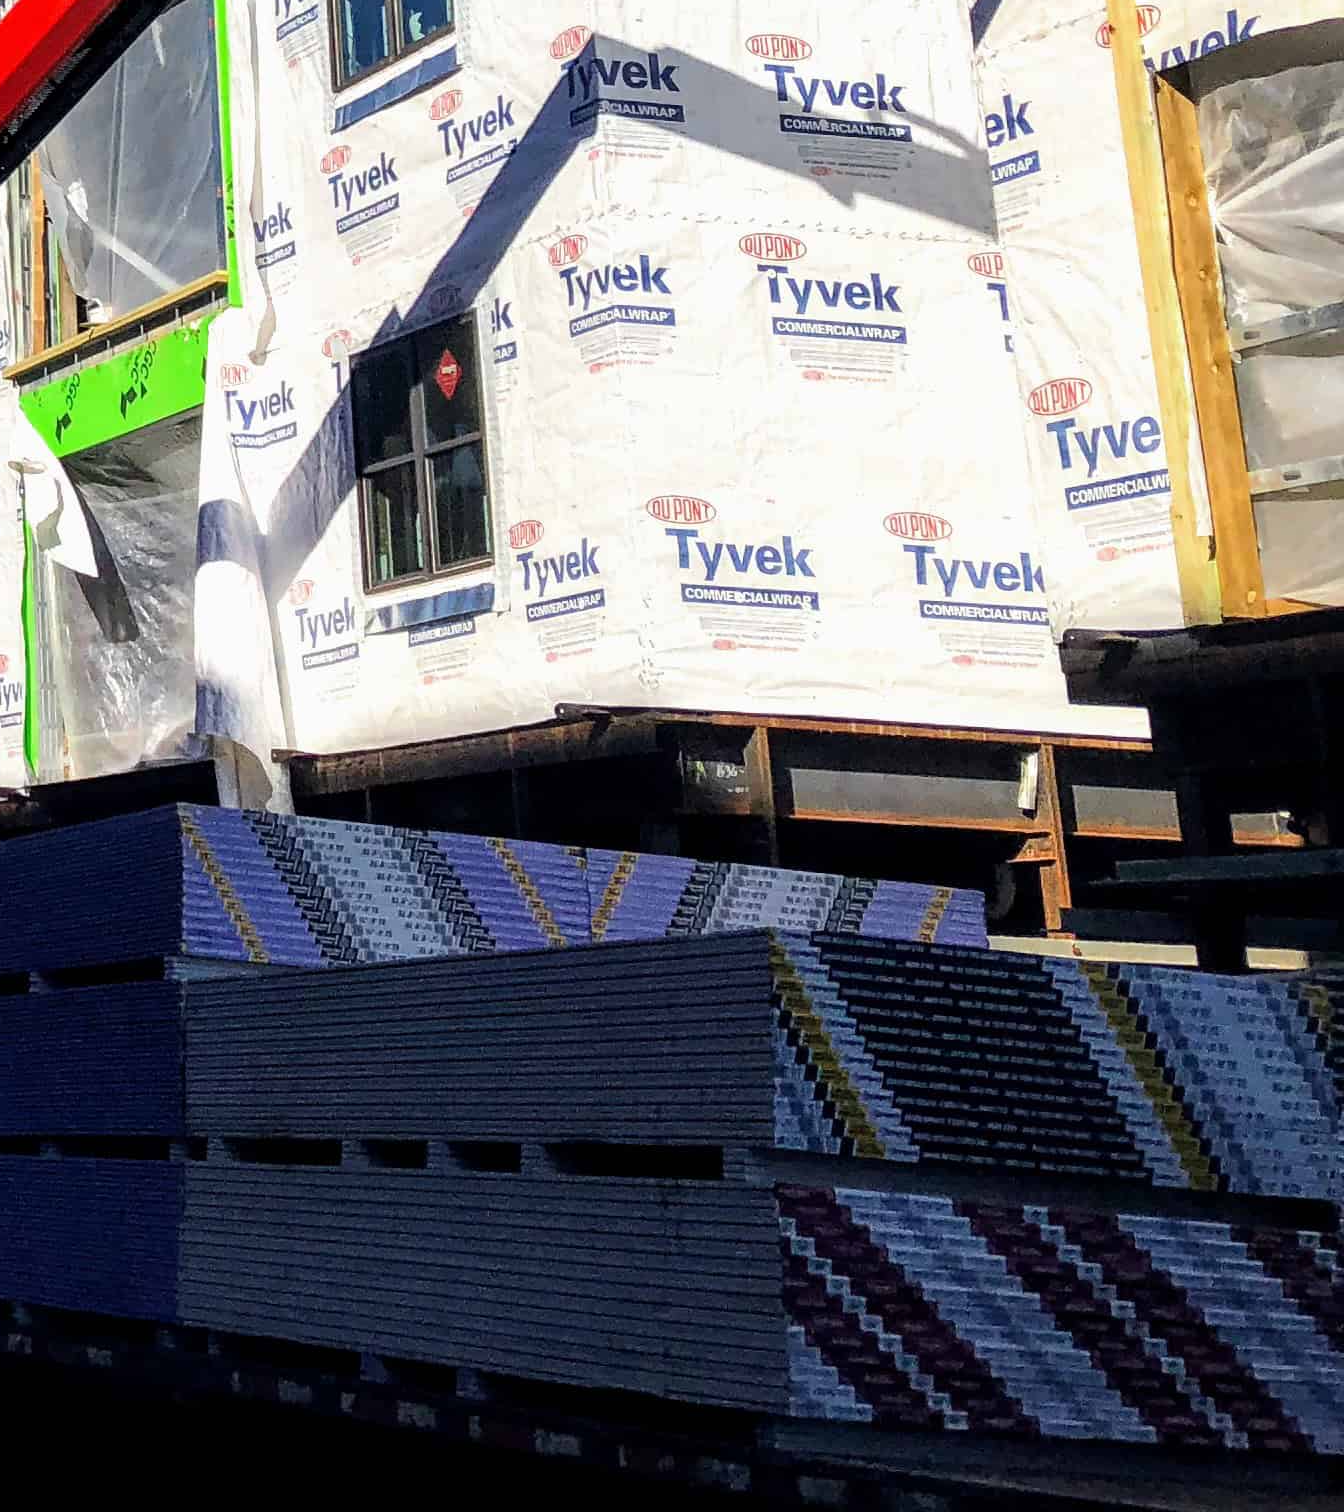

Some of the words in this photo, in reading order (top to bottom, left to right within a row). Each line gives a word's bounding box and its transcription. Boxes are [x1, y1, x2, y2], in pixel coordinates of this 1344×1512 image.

[561, 54, 680, 99] Tyvek
[764, 64, 907, 112] Tyvek
[438, 95, 515, 159] Tyvek
[783, 117, 907, 138] COMMERCIALWRAP
[328, 152, 399, 212] Tyvek
[254, 202, 292, 242] vek
[560, 255, 672, 307] Tyvek
[758, 265, 903, 314] Tyvek
[571, 306, 672, 336] COMMERCIALWRAP
[775, 320, 901, 340] COMMERCIALWRAP
[66, 373, 80, 410] CGC
[224, 381, 296, 429] Tyvek
[1046, 416, 1160, 478] Tyve
[517, 538, 601, 597] Tyvek
[665, 528, 817, 581] Tyvek
[685, 587, 813, 609] COMMERCIALWRAP
